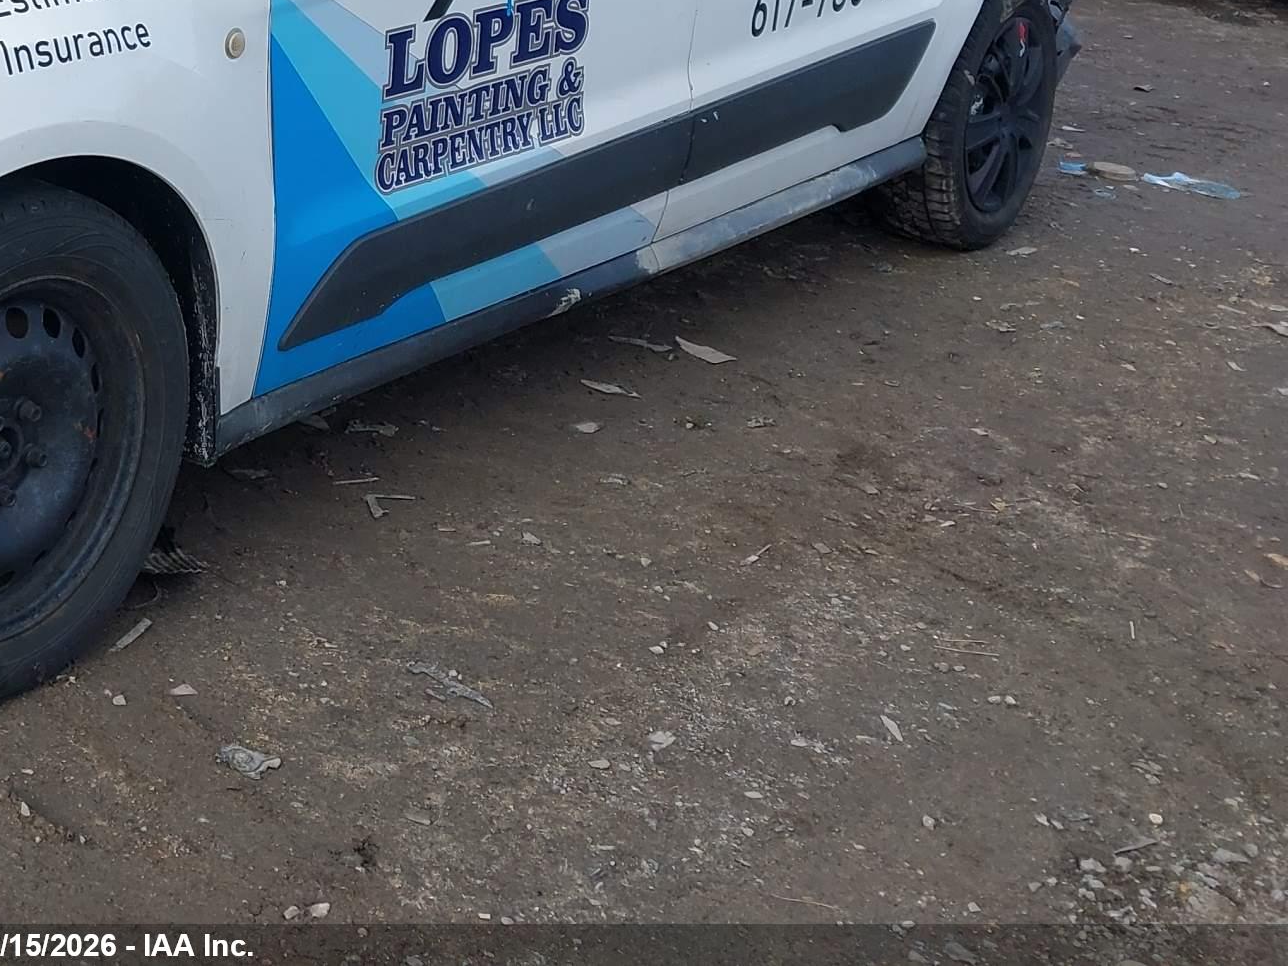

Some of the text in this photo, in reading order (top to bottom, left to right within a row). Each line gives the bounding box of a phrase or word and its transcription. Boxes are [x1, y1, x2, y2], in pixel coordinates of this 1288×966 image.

[0, 22, 152, 76] Insurance
[376, 97, 584, 191] CARPENTRY LLC
[380, 59, 583, 149] PAINTING &
